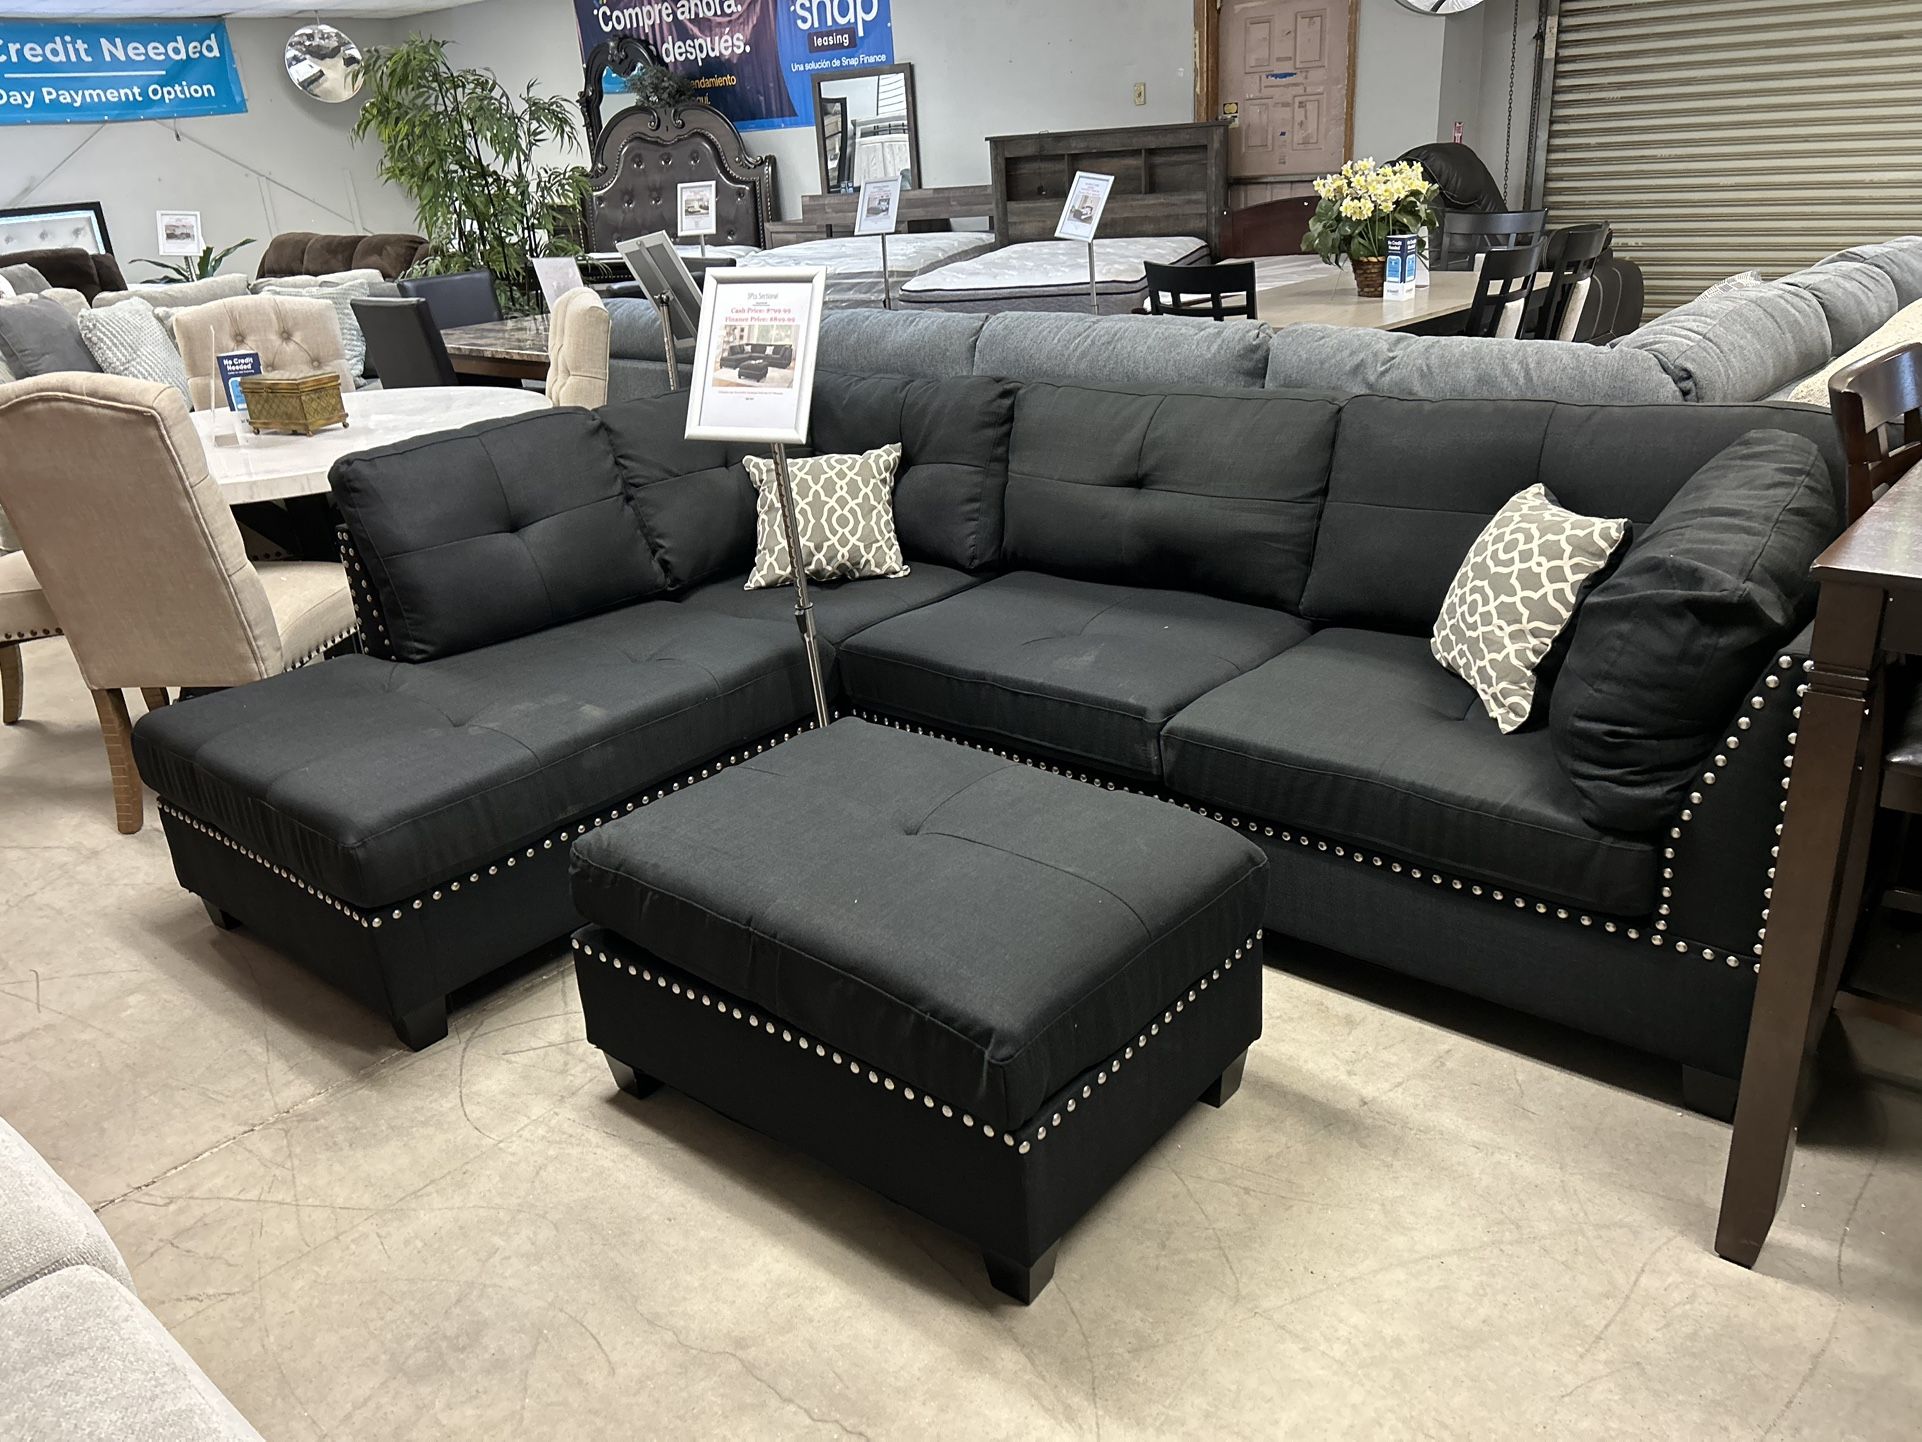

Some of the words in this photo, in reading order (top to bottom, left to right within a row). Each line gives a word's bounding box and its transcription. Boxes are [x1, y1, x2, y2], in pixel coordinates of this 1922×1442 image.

[599, 1, 673, 33] Compre
[100, 33, 221, 62] Needed
[661, 27, 751, 66] después.
[813, 33, 850, 47] leasing
[791, 62, 804, 72] Una
[805, 58, 831, 71] solución
[831, 57, 841, 67] de
[841, 56, 859, 67] Snap
[860, 53, 887, 64] Finance
[41, 85, 143, 107] Payment
[148, 80, 216, 104] Option
[690, 74, 737, 89] endamiento
